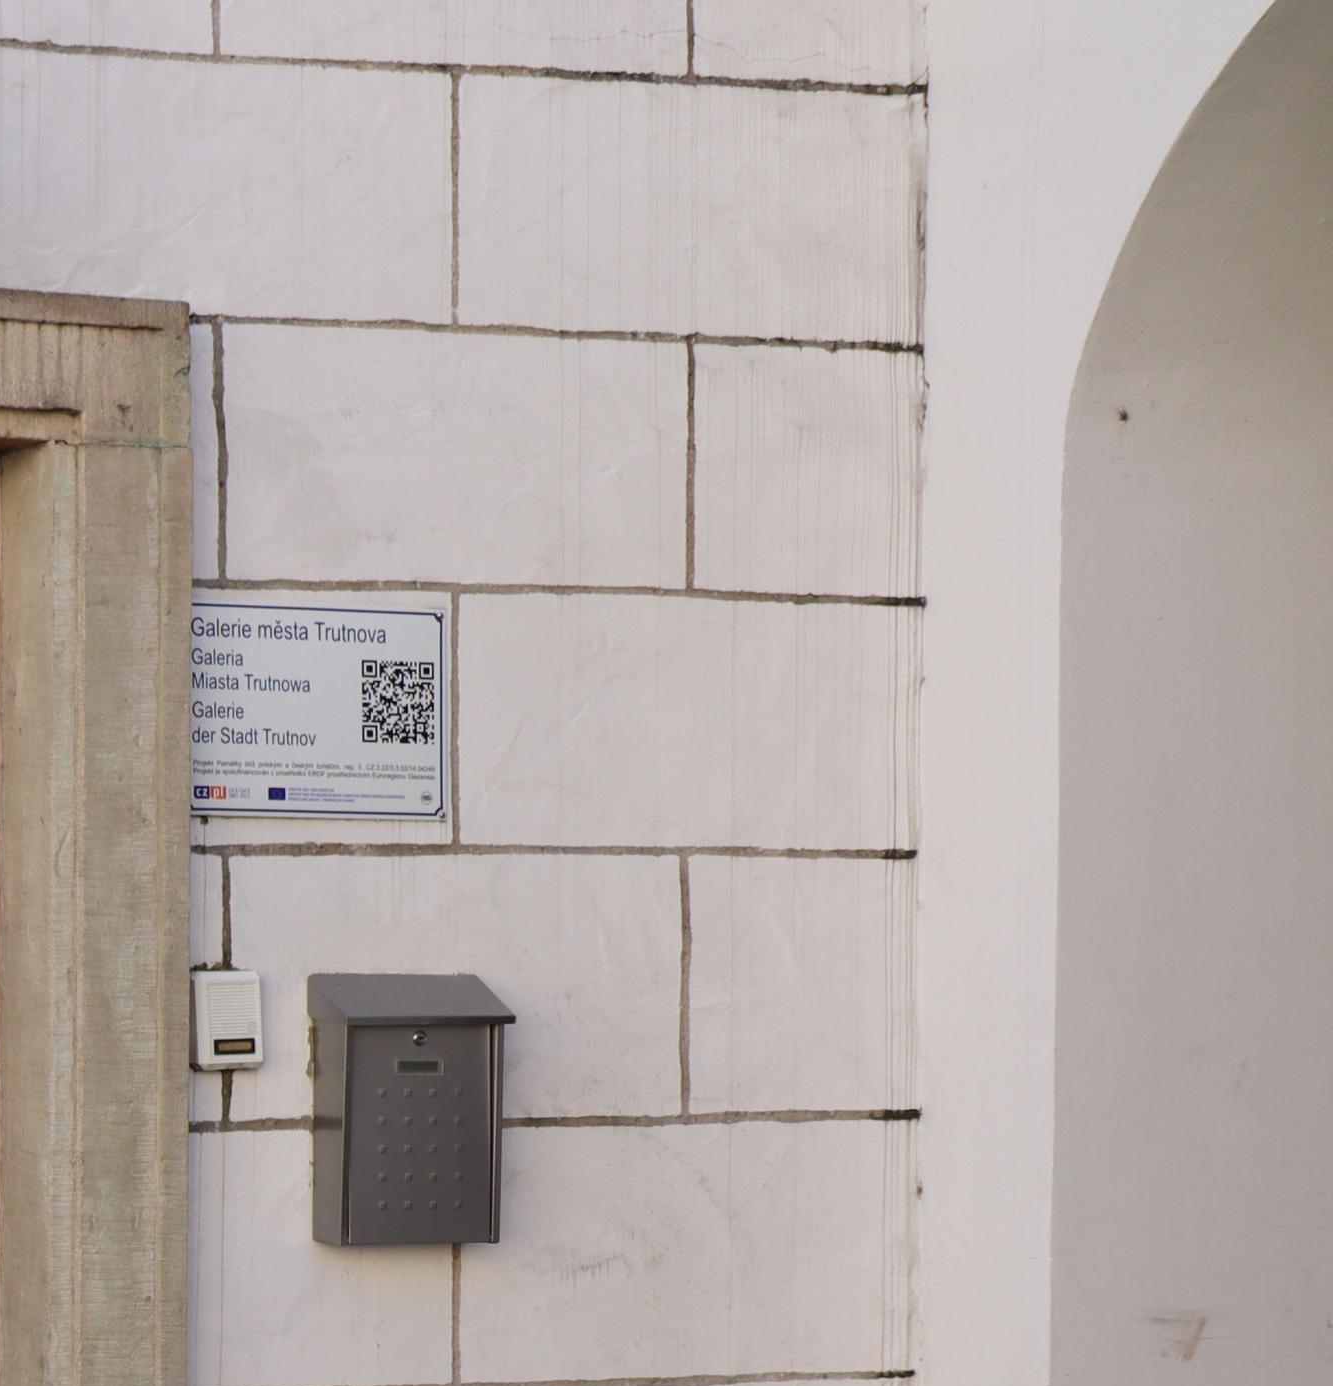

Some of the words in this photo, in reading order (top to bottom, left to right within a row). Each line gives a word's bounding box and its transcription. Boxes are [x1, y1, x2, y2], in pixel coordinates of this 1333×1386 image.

[190, 616, 252, 639] Galerie
[258, 620, 309, 641] města
[314, 621, 387, 644] Trutnova
[191, 647, 244, 667] Galeria
[192, 672, 239, 690] Miasta
[244, 673, 311, 693] Trutnowa
[192, 700, 244, 720] Galerie
[192, 726, 216, 744] der
[220, 726, 258, 745] Stadt
[262, 728, 317, 747] Trutnov
